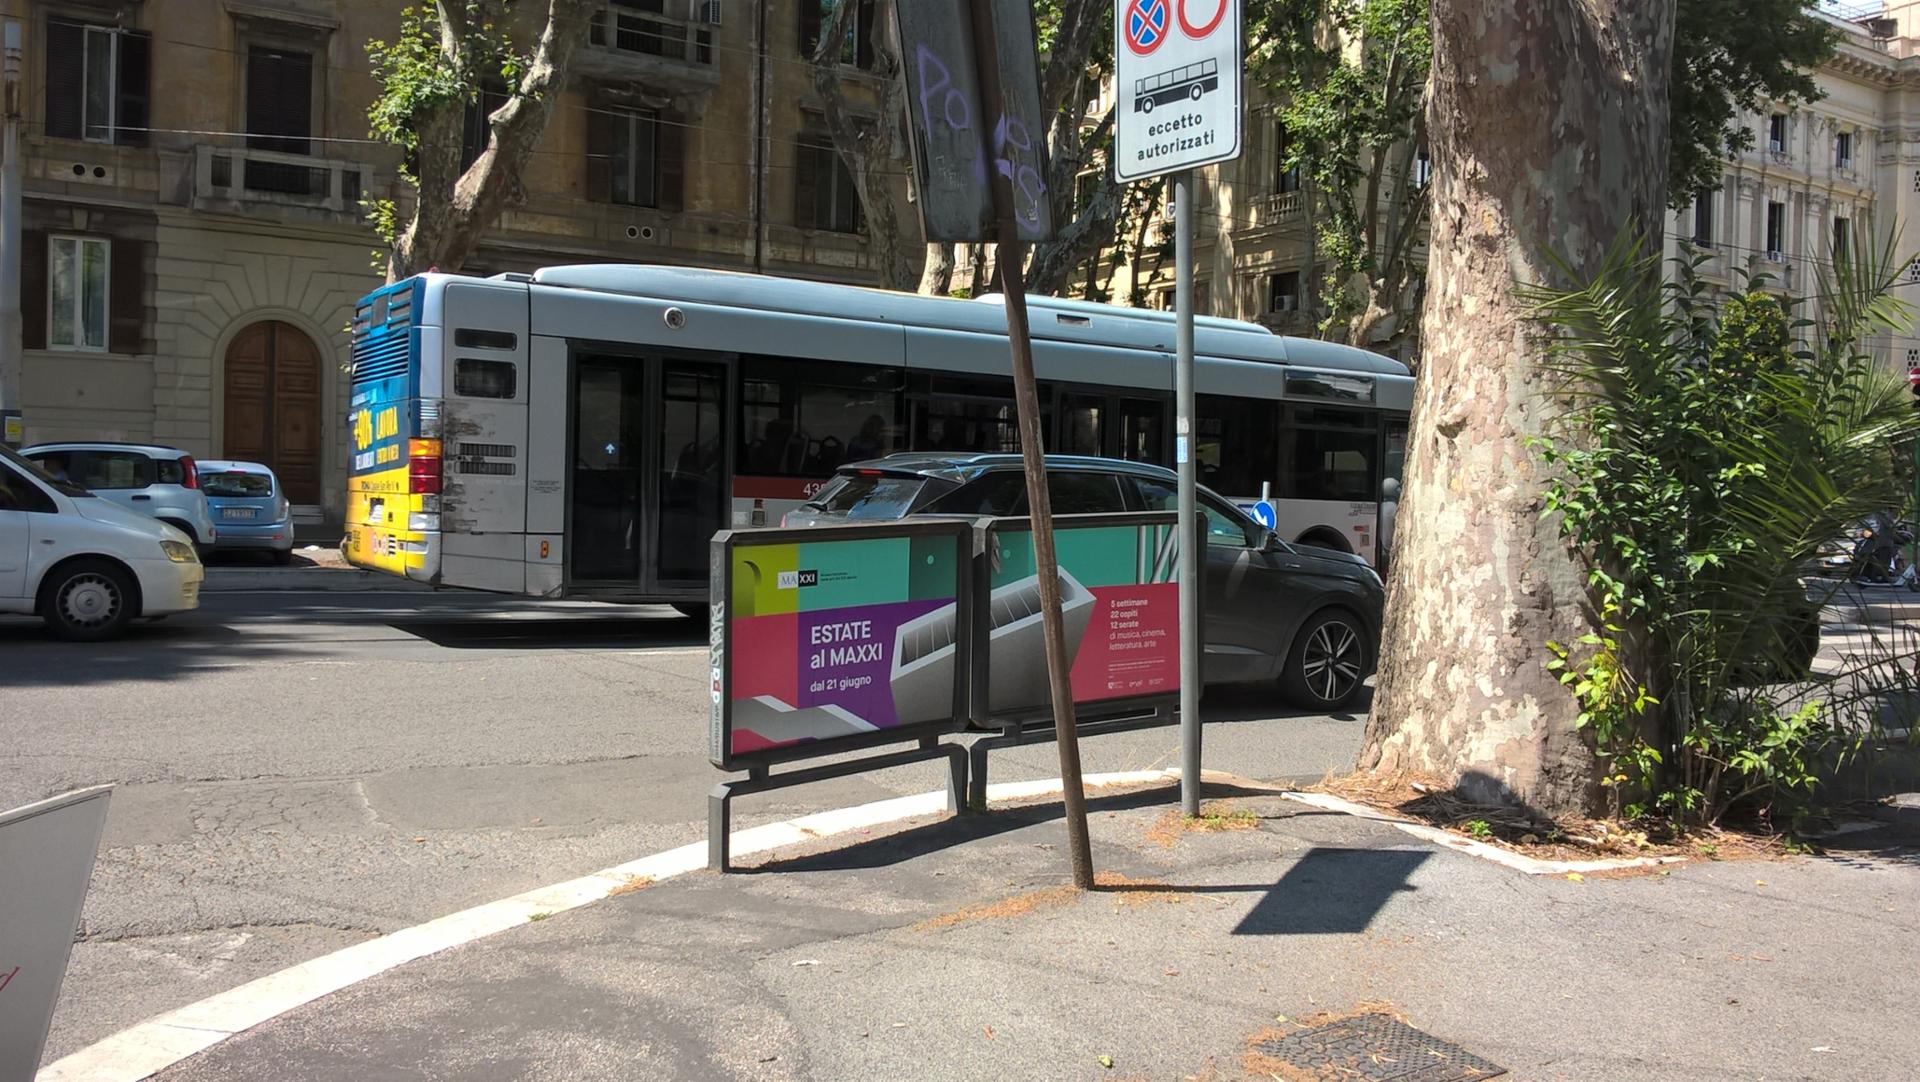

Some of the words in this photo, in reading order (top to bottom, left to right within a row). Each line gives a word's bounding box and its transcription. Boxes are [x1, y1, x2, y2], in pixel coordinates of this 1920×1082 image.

[1148, 113, 1203, 137] eccetto
[1137, 129, 1214, 161] autorizzati
[781, 573, 816, 585] MAXXI
[1110, 600, 1116, 608] 5
[1116, 599, 1148, 608] settimane
[1110, 611, 1119, 619] 22
[811, 620, 872, 645] ESTATE
[1118, 621, 1139, 629] serate
[810, 649, 825, 670] al
[830, 643, 883, 667] MAXXI
[810, 680, 825, 692] dal
[826, 678, 837, 690] 21
[839, 676, 872, 691] giugno
